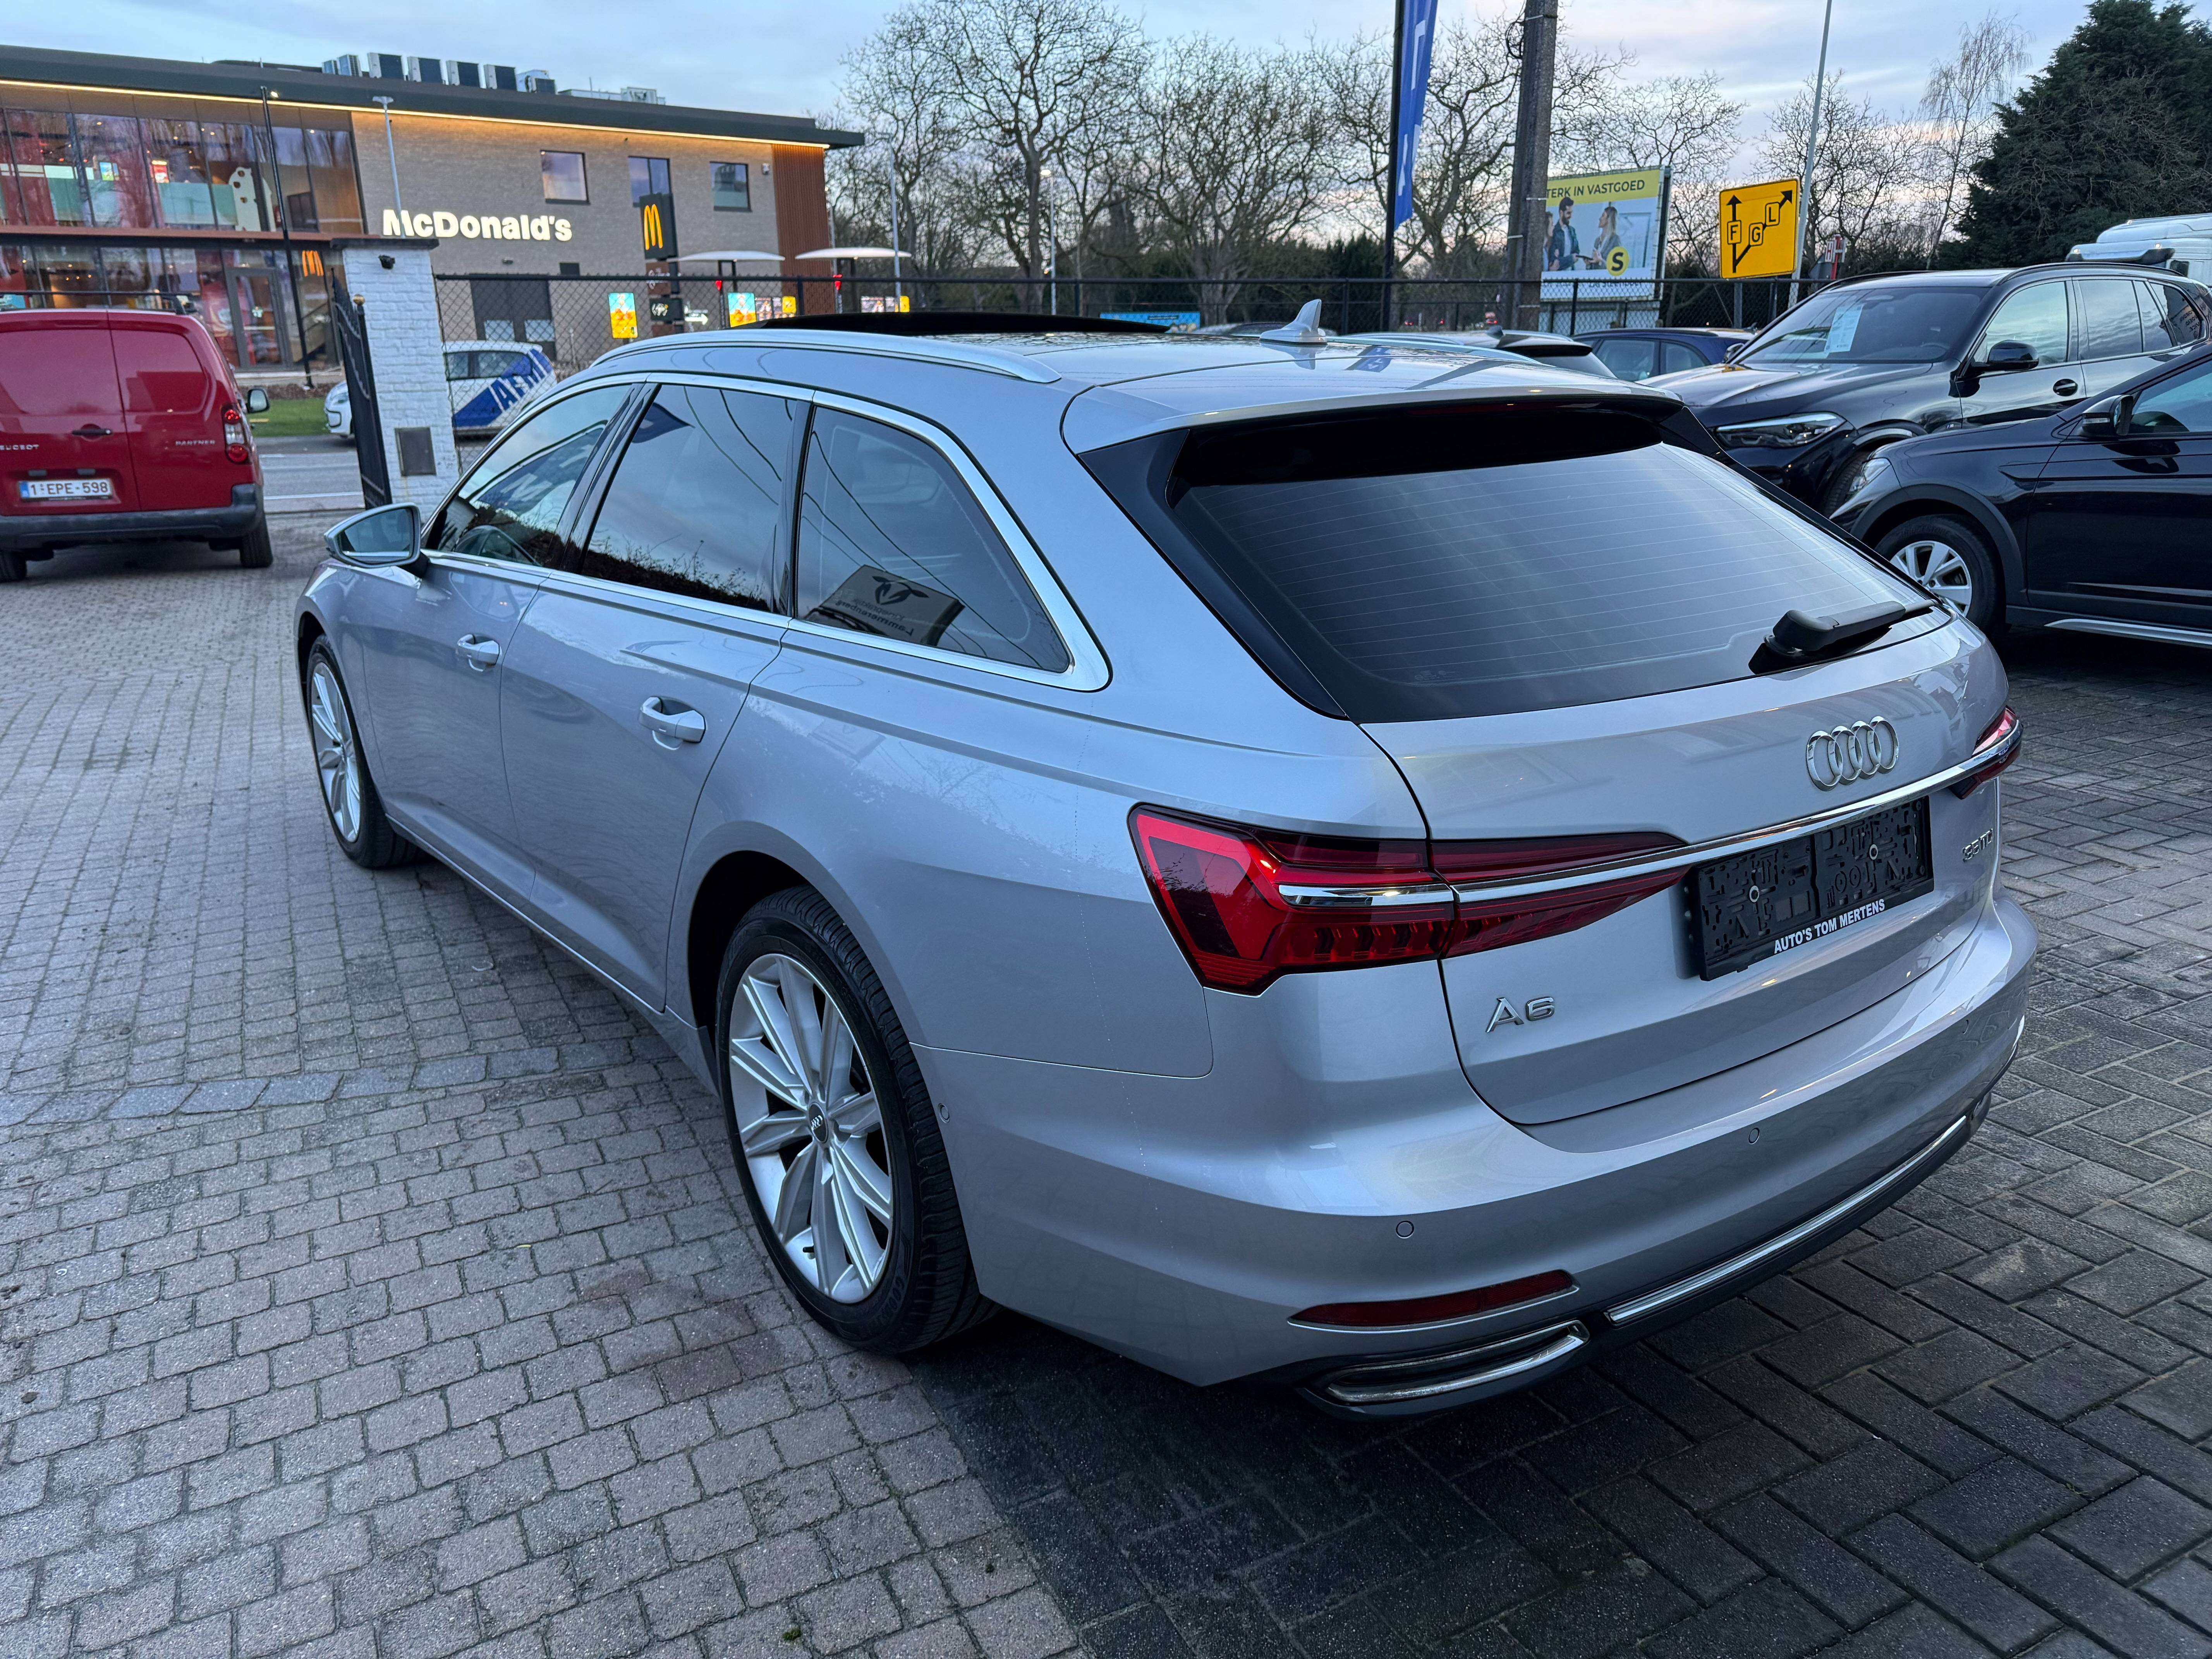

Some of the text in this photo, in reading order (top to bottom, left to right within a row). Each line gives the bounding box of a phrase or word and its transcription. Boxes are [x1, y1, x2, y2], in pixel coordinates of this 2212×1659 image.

[1546, 180, 1645, 199] TERK IN VASTGOED
[1769, 207, 1776, 222] L
[383, 209, 572, 242] McDonald's
[1731, 225, 1738, 240] F
[1752, 227, 1760, 242] G
[1610, 252, 1625, 272] S
[1774, 898, 1885, 954] AUTO'S TOM MERTENS
[1485, 996, 1555, 1033] A6
